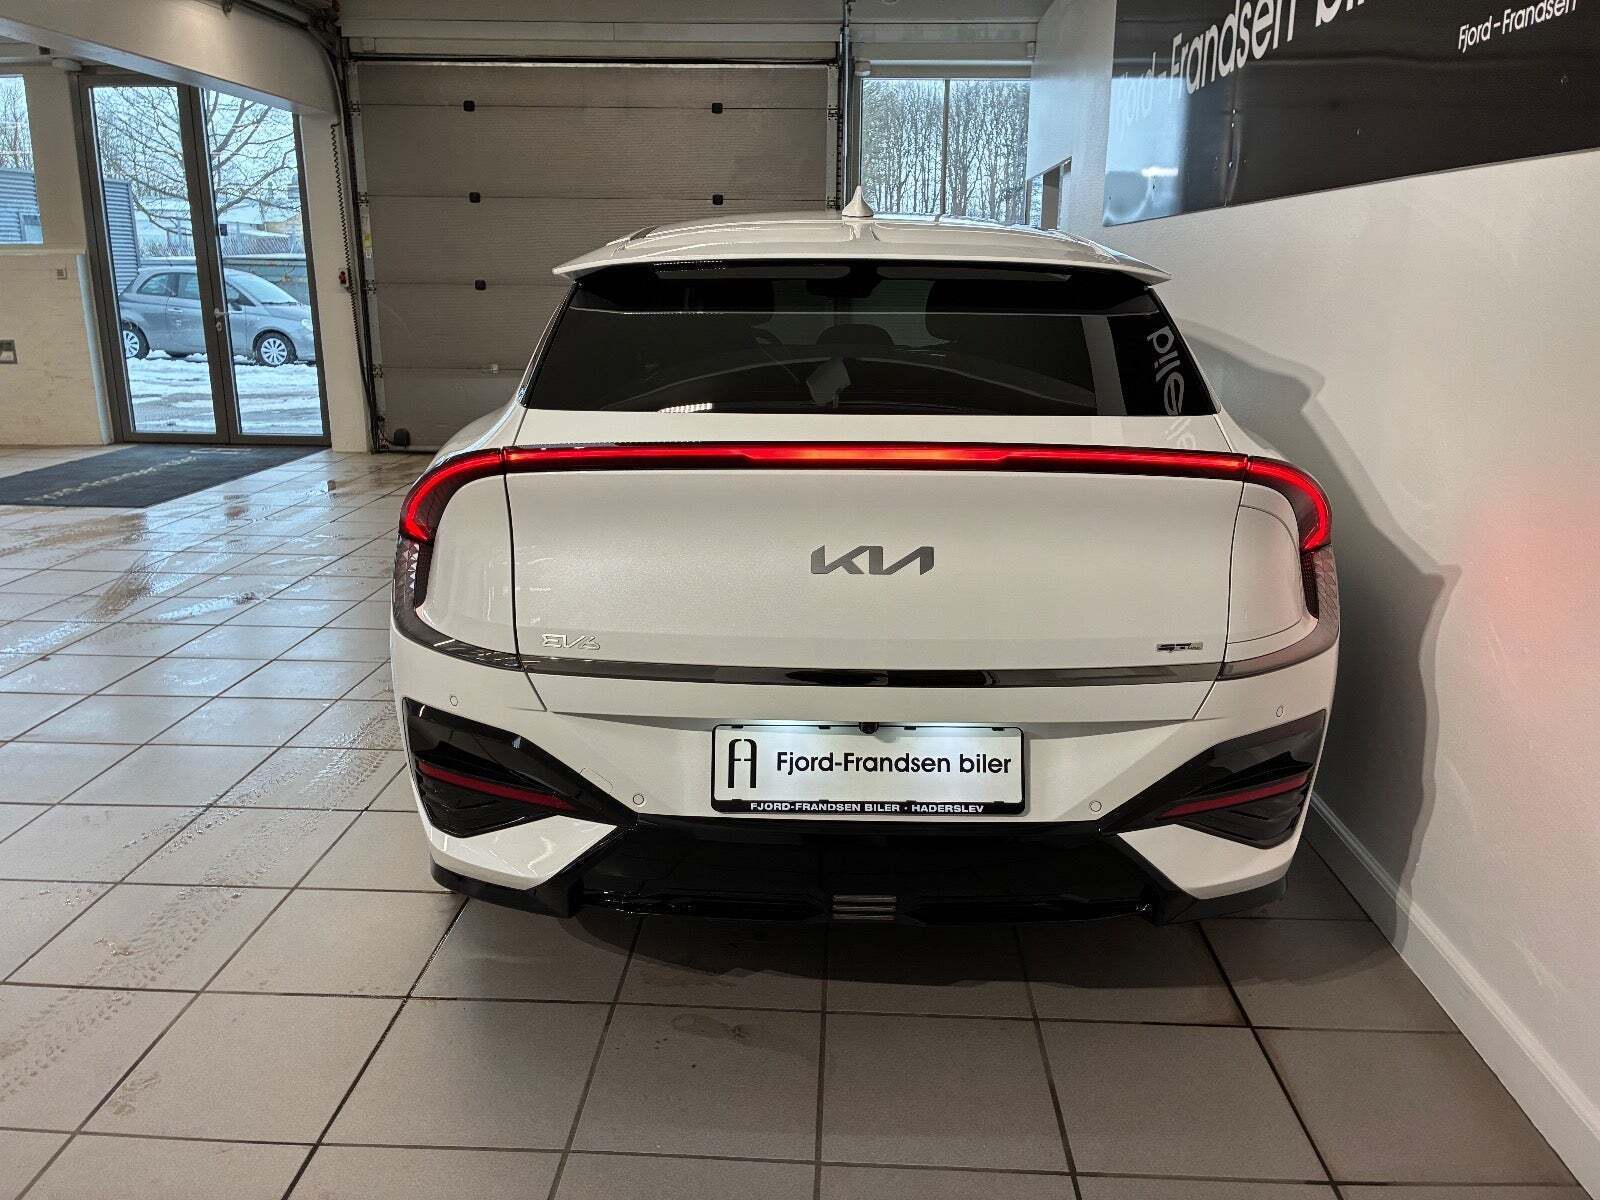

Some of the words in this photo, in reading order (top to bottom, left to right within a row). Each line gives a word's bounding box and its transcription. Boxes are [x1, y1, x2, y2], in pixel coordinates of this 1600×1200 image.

[1458, 0, 1577, 53] Fjord-Frandsen
[811, 545, 934, 575] KIA
[541, 633, 600, 650] EV6
[776, 751, 951, 776] Fjord-Frandsen
[959, 753, 1012, 774] biler
[750, 802, 861, 812] FJORD-FRANDSEN
[864, 803, 900, 813] BILER
[911, 804, 984, 813] HADERSLEV
